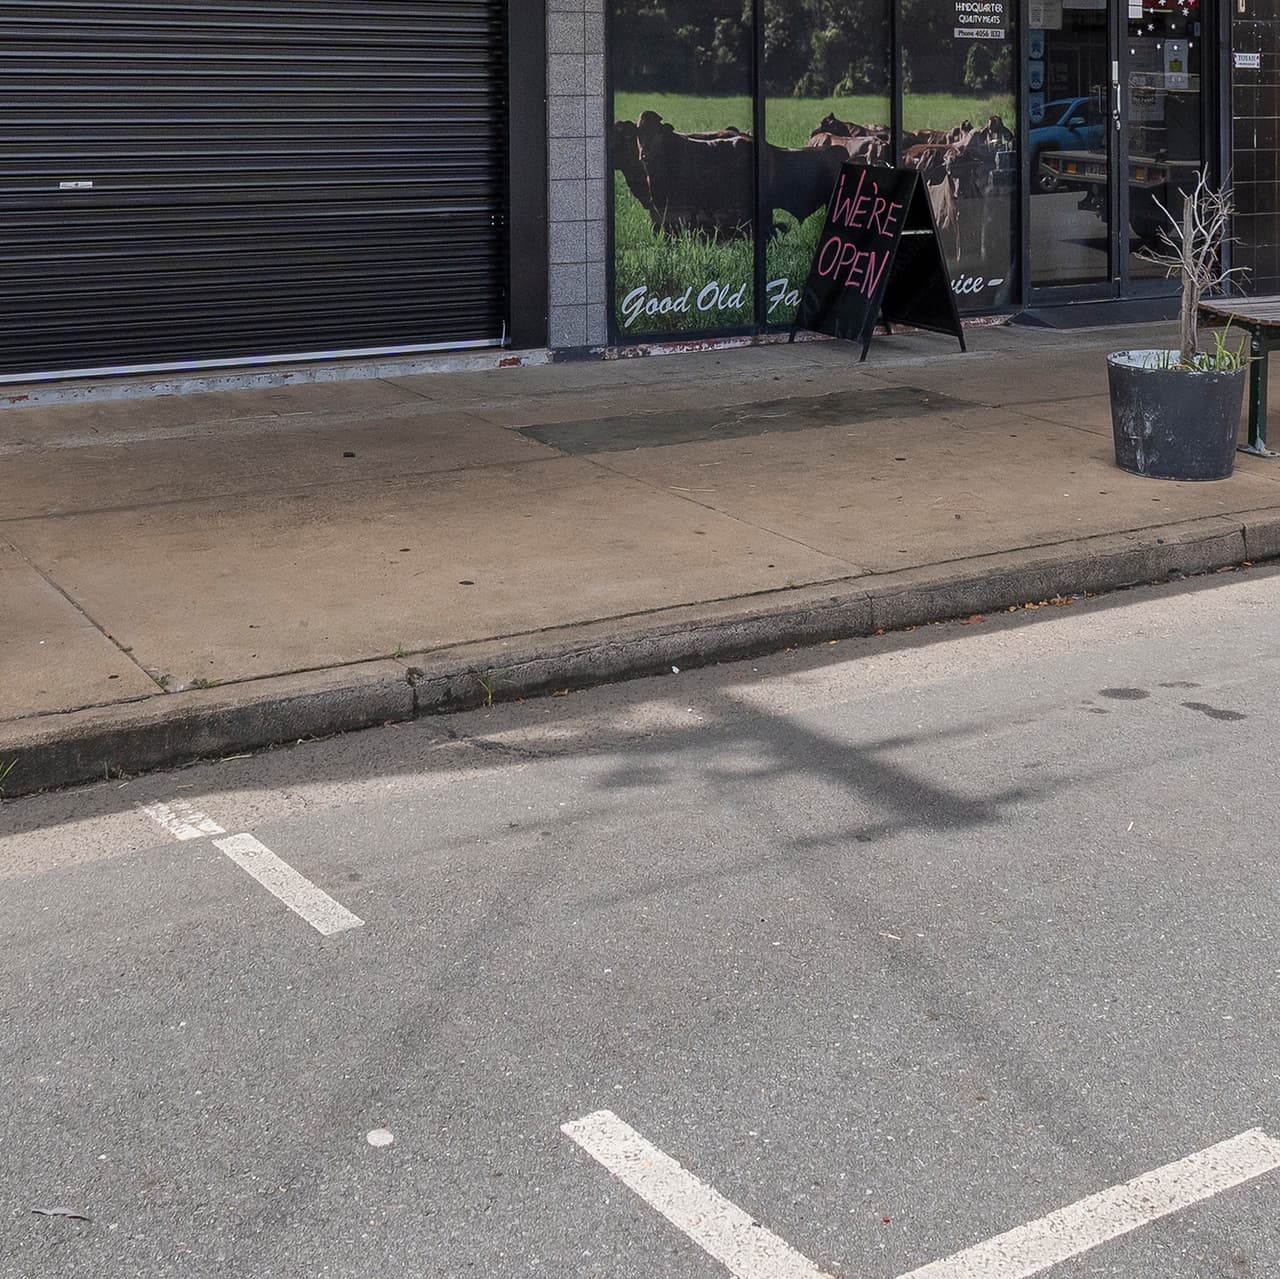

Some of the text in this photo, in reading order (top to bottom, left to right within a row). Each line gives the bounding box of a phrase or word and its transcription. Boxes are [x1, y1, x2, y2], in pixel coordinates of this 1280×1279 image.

[831, 169, 904, 238] WE'RE
[818, 235, 890, 299] OPEN
[621, 285, 691, 327] Good
[696, 281, 745, 312] Old
